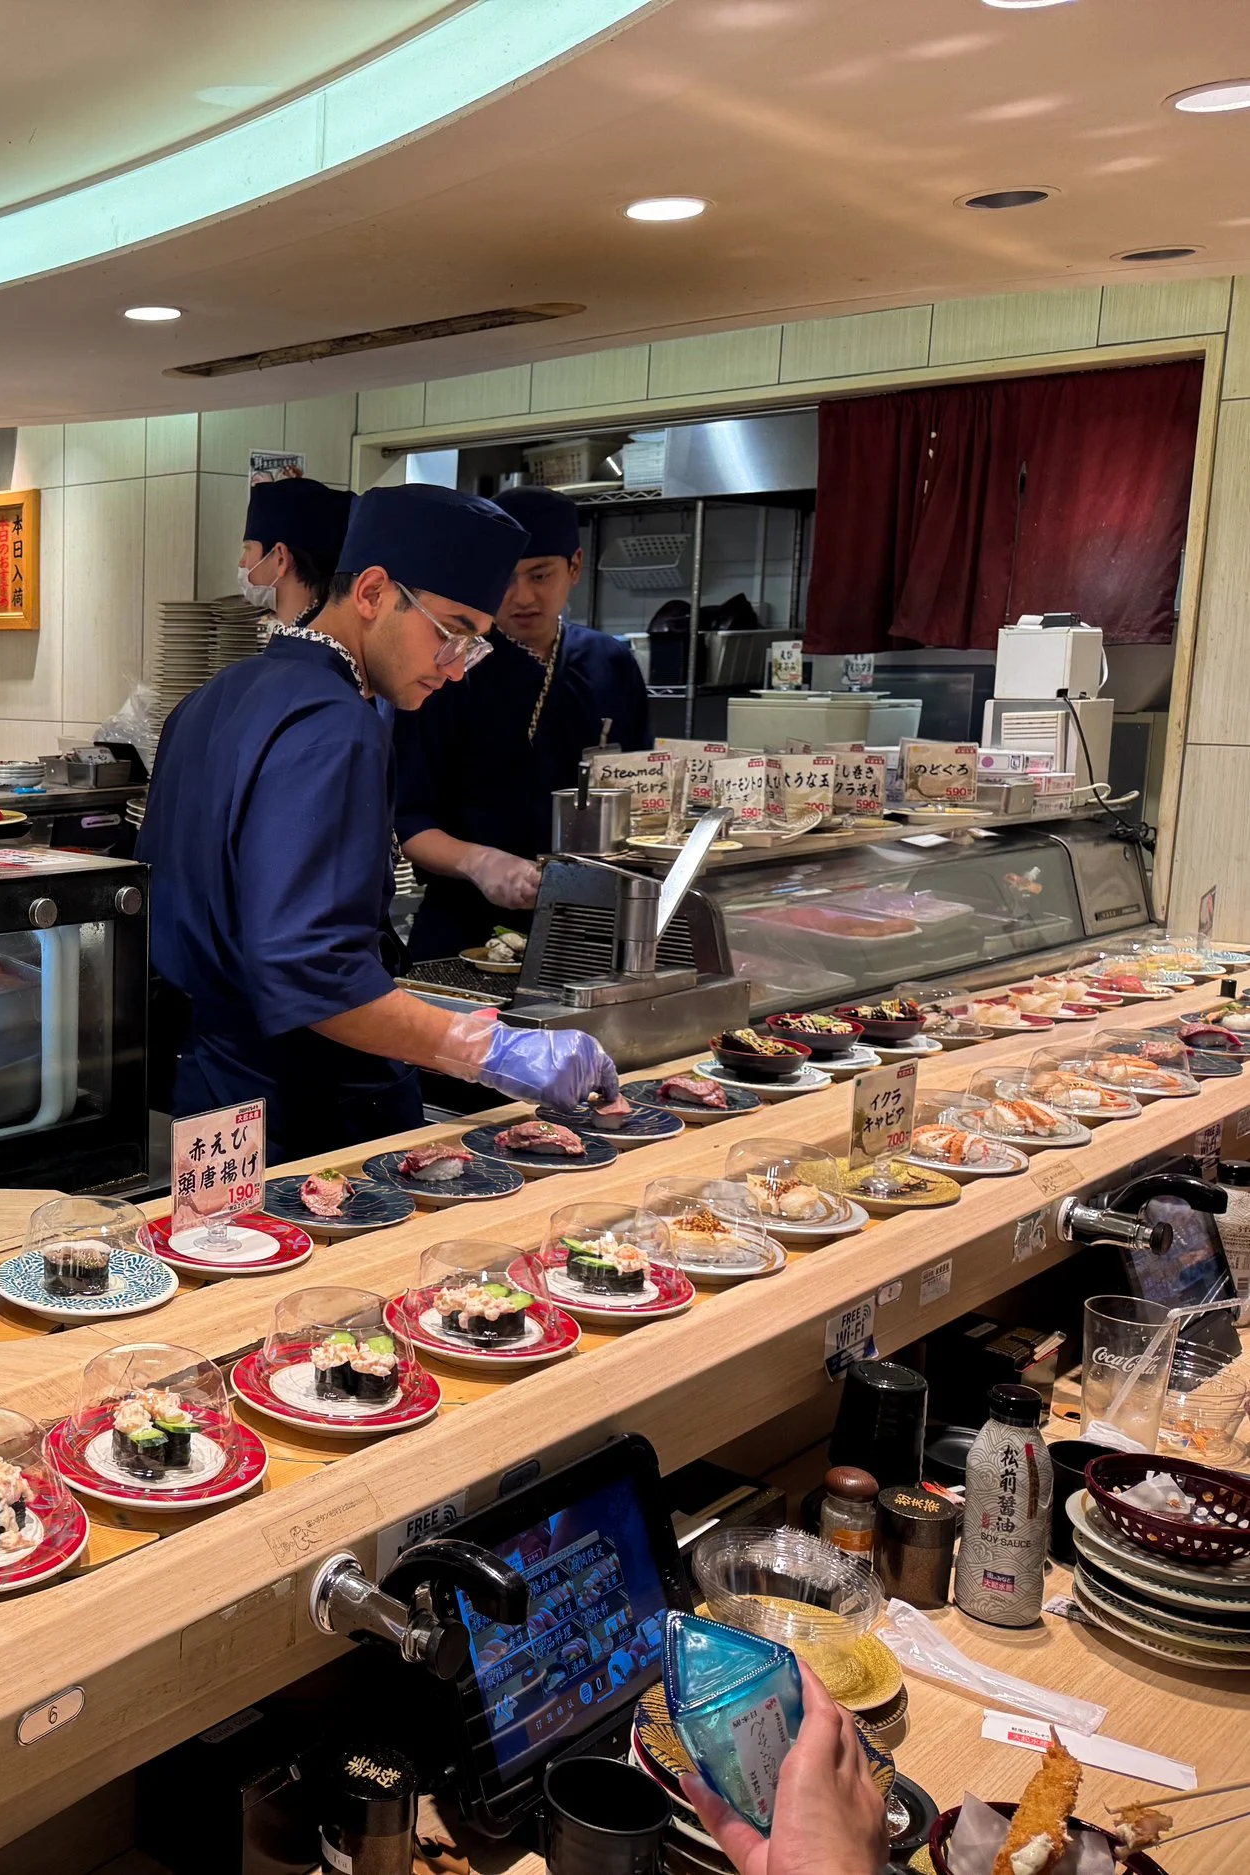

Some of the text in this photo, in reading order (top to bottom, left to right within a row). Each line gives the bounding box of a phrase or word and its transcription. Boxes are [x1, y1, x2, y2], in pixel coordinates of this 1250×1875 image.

[11, 514, 23, 608] 本日入荷
[601, 763, 664, 781] Steamed
[914, 763, 969, 776] のどぐろ
[629, 781, 667, 794] sters
[835, 782, 879, 798] クラ添え
[870, 1088, 902, 1111] イクラ
[863, 1107, 905, 1132] キャビア
[189, 1126, 248, 1161] 赤えび
[178, 1151, 258, 1196] 頭唐揚げ
[842, 1307, 861, 1328] FREE
[836, 1321, 865, 1351] Wi-Fi
[1092, 1346, 1162, 1375] Coca-Cla
[407, 1508, 439, 1538] FREE
[981, 1532, 1032, 1549] SOY SAUCE
[596, 1677, 603, 1691] 0
[48, 1705, 59, 1724] 6
